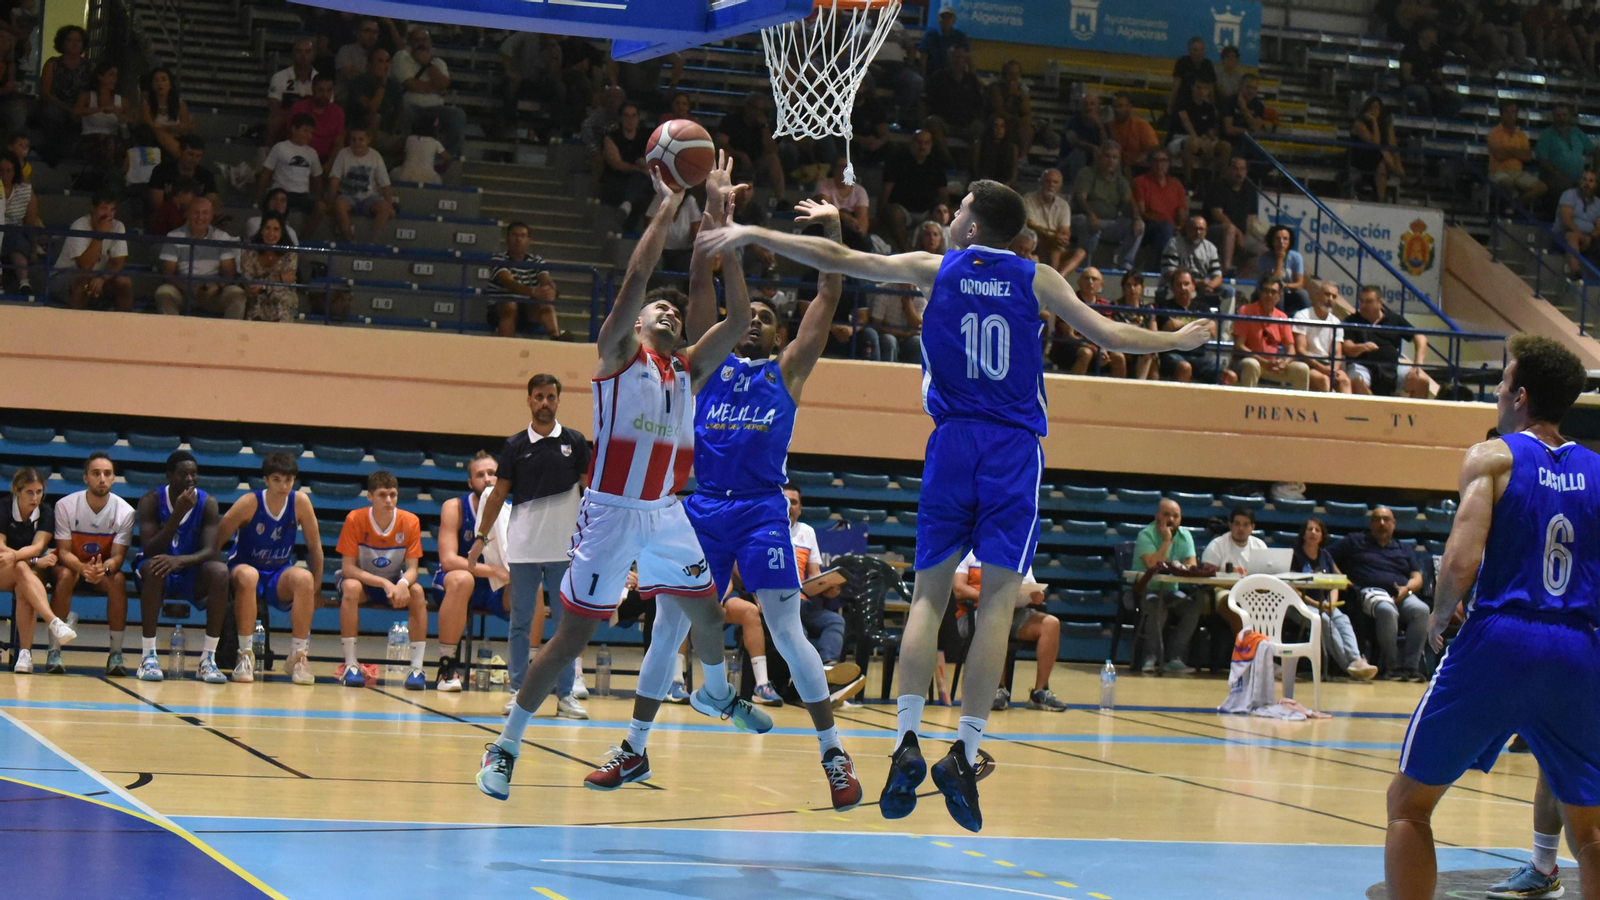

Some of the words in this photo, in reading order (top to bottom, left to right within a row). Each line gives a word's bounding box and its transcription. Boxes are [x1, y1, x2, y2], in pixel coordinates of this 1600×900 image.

[971, 11, 1024, 27] Algeciras
[1117, 25, 1168, 41] Algeciras
[960, 278, 1011, 297] ORDOÑEZ
[960, 312, 1011, 381] 10
[733, 373, 751, 393] 21
[665, 389, 671, 414] 1
[706, 402, 776, 425] MELILLA
[1244, 404, 1319, 424] PRENSA
[1538, 466, 1586, 493] CASTILLO
[767, 547, 786, 570] 21
[1543, 513, 1575, 597] 6
[588, 572, 600, 597] 1
